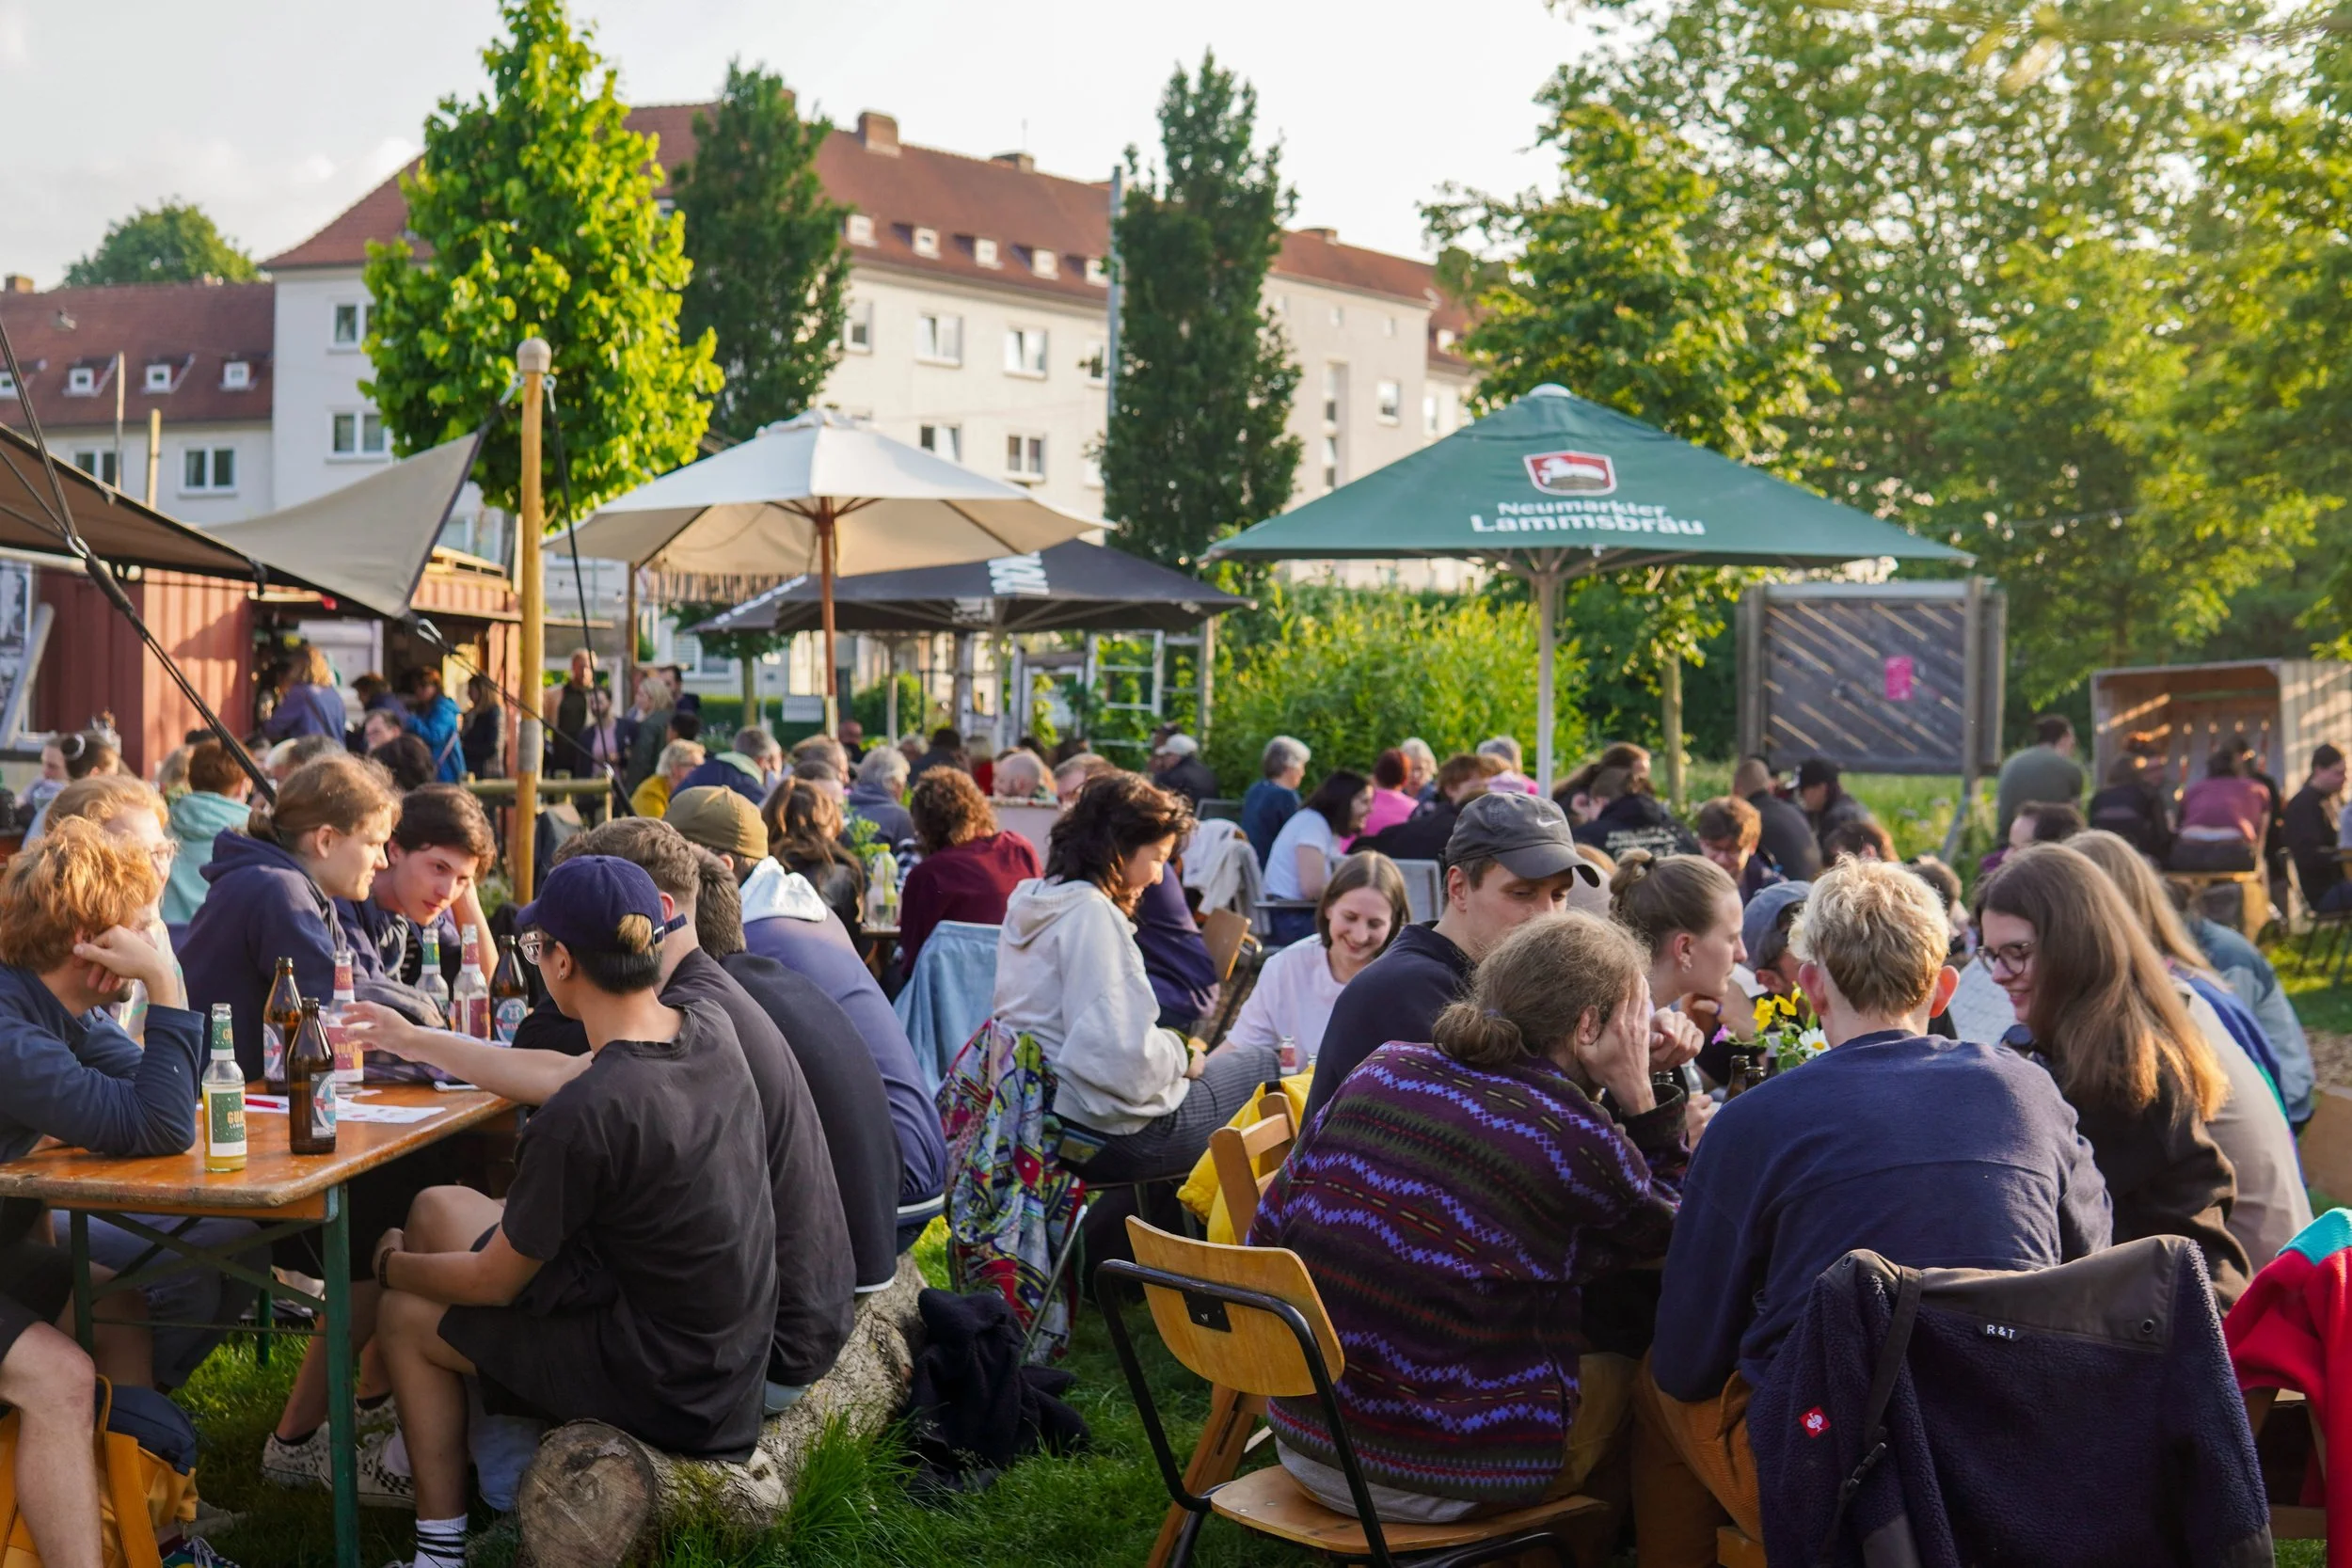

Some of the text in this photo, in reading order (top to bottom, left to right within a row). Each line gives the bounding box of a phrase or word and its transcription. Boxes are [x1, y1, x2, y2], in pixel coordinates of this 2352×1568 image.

[1497, 499, 1667, 518] Neumarkter
[1470, 513, 1706, 535] Lammsbräu
[1986, 1323, 2016, 1339] R&T
